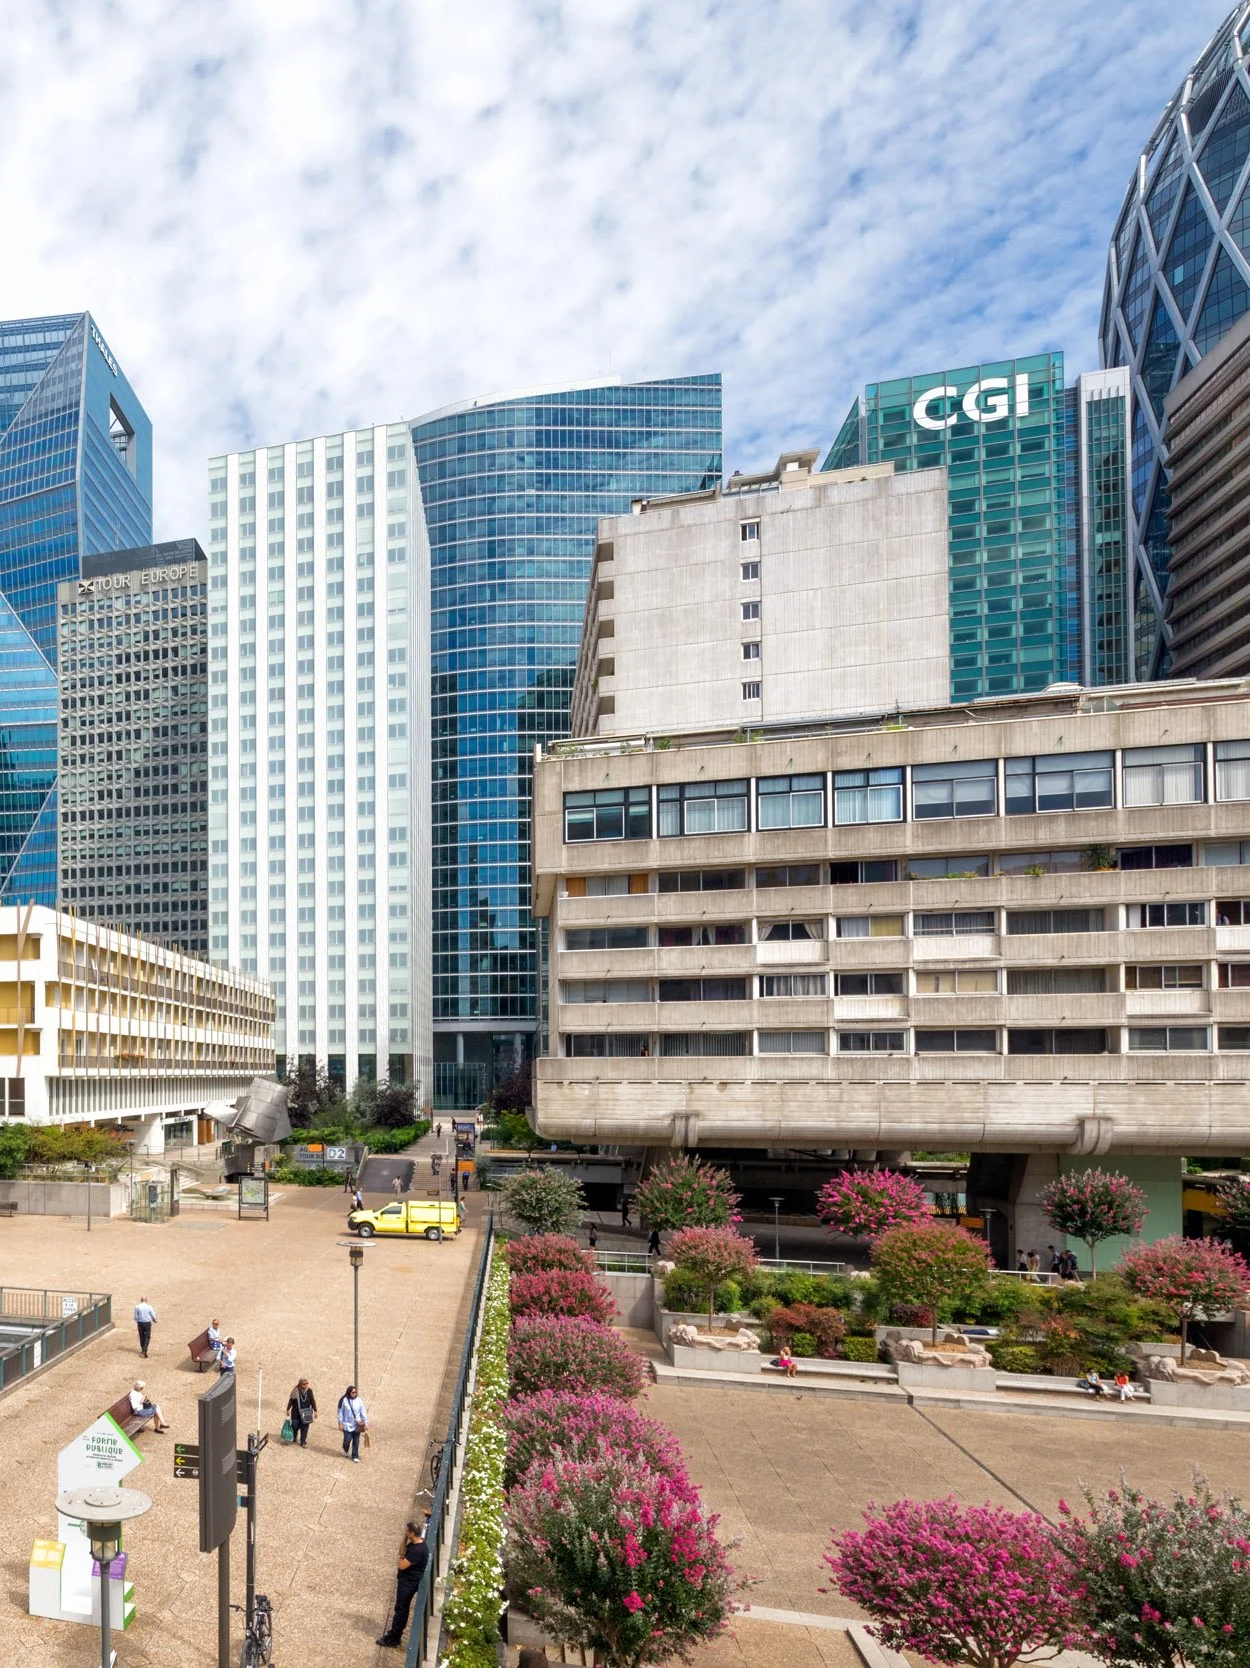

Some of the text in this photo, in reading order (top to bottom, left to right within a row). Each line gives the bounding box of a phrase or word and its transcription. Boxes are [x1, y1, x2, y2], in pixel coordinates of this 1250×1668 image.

[91, 324, 118, 377] THALES
[913, 373, 1029, 431] CGI
[96, 564, 198, 590] TOUR EUROPE
[328, 1148, 345, 1159] D2
[85, 1444, 123, 1456] PUBLIQUE
